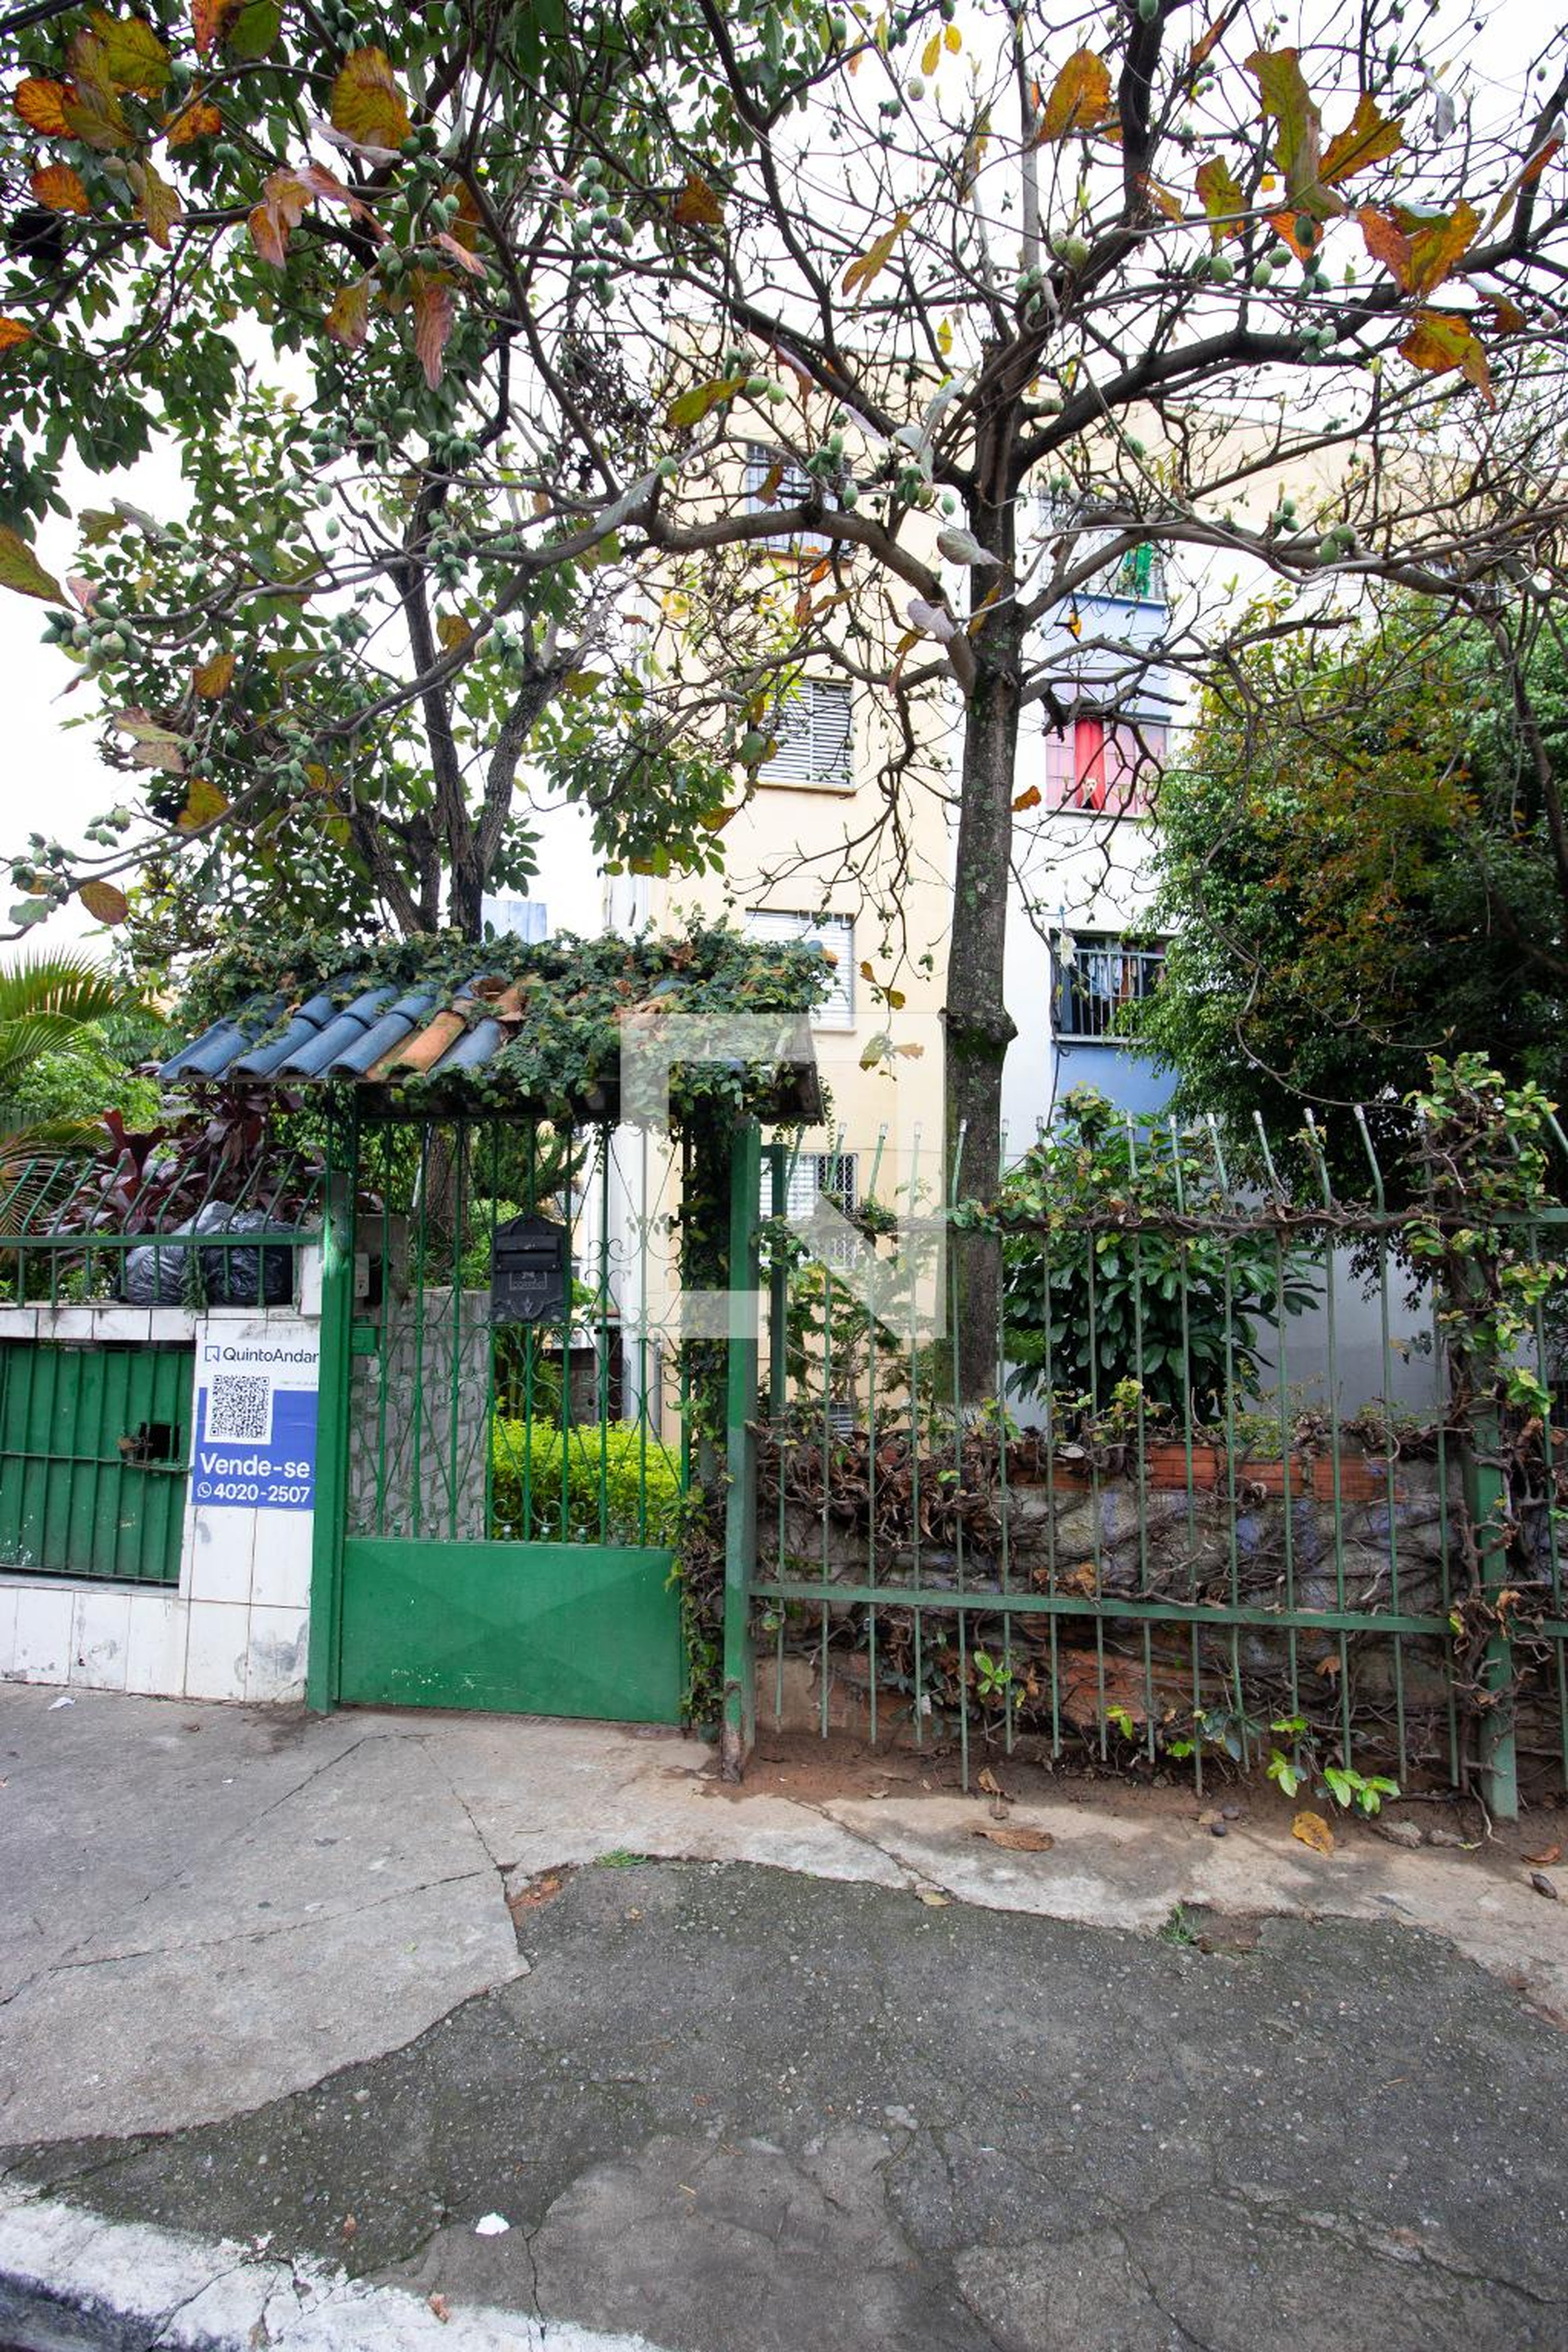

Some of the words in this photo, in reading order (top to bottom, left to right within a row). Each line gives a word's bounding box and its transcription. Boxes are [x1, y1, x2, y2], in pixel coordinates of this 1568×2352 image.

[223, 1347, 319, 1363] QuintoAndar
[200, 1453, 310, 1478] Vende-se
[214, 1483, 310, 1503] 4020-2507
